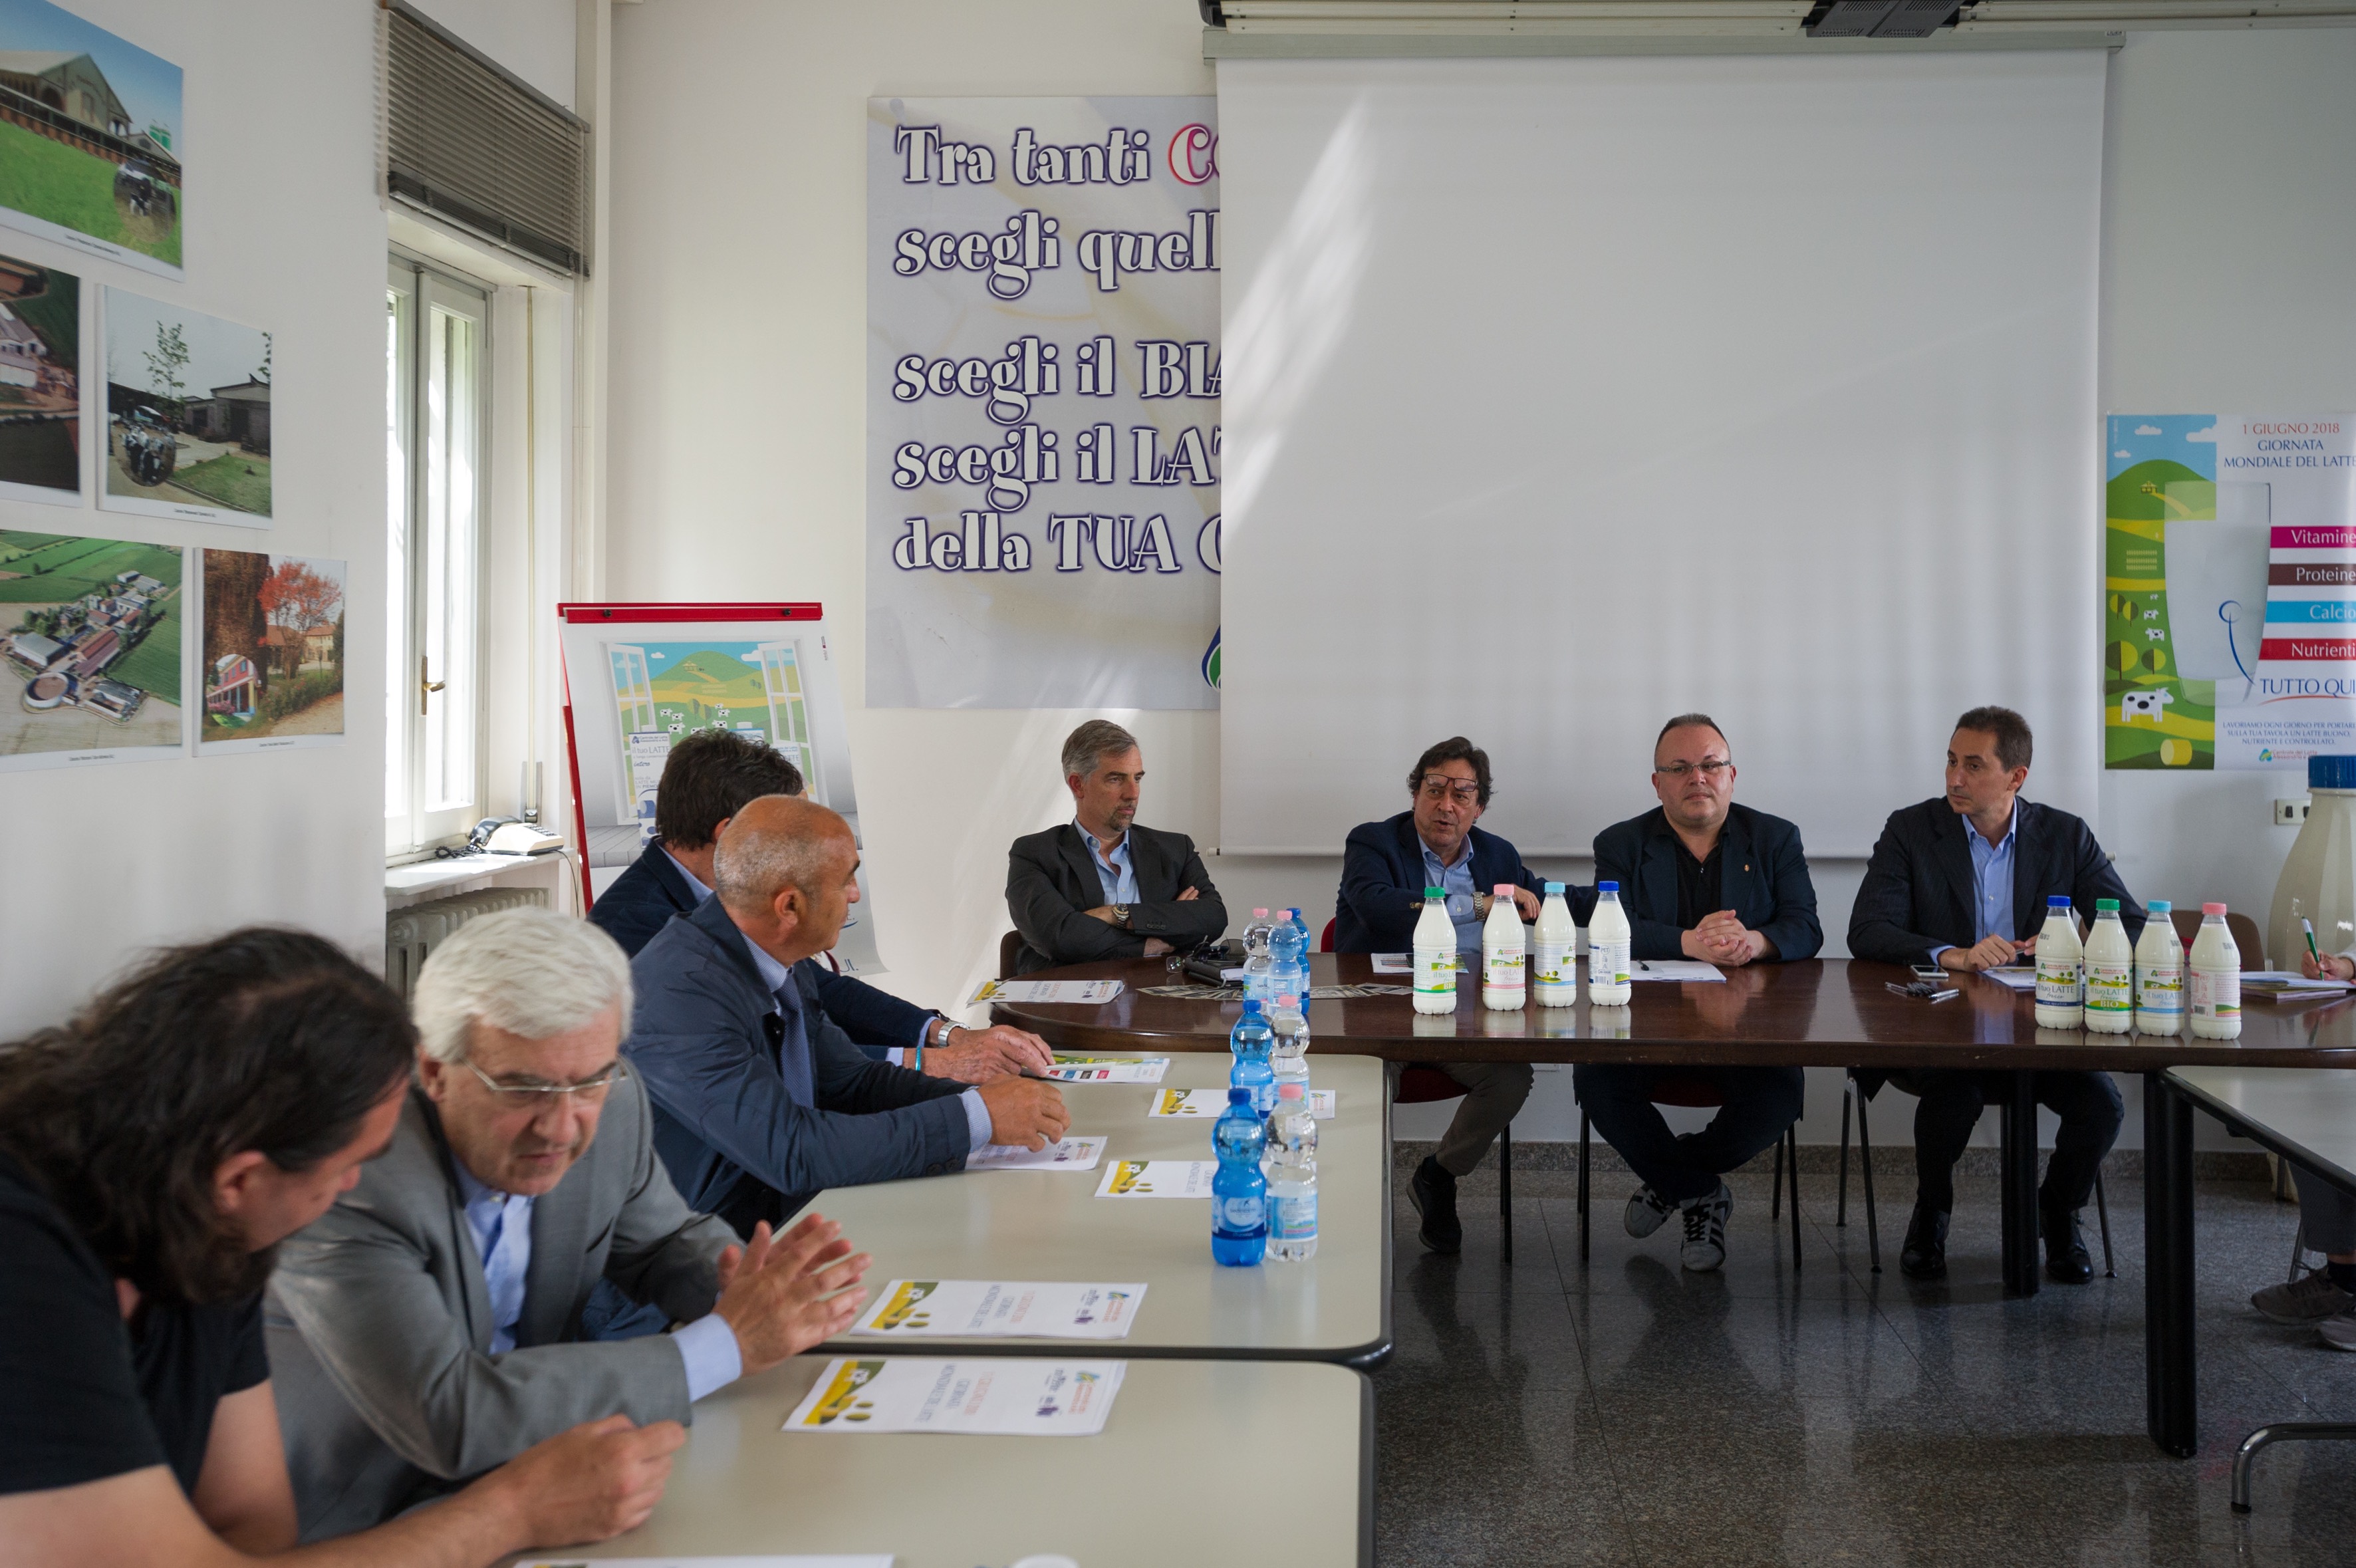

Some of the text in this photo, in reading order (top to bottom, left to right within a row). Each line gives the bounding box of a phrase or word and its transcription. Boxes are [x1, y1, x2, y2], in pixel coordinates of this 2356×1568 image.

[896, 122, 1220, 184] Tra tanti C
[893, 210, 1060, 300] scegli
[893, 335, 1059, 426] scegli
[1076, 334, 1114, 396] il
[2243, 422, 2340, 435] 1 GIUGNO 2018
[2258, 440, 2323, 452] GIORNATA
[893, 423, 1221, 513] scegli il LA
[2224, 456, 2292, 468] MONDIALE
[2296, 456, 2319, 467] DEL
[893, 511, 1031, 573] della
[1048, 513, 1182, 573] TUA
[2291, 529, 2356, 544] Vitamine
[2296, 567, 2356, 582] Proteine
[2309, 604, 2356, 620] Calcio
[2291, 642, 2355, 657] Nutrienti
[2260, 678, 2319, 695] TUTTO
